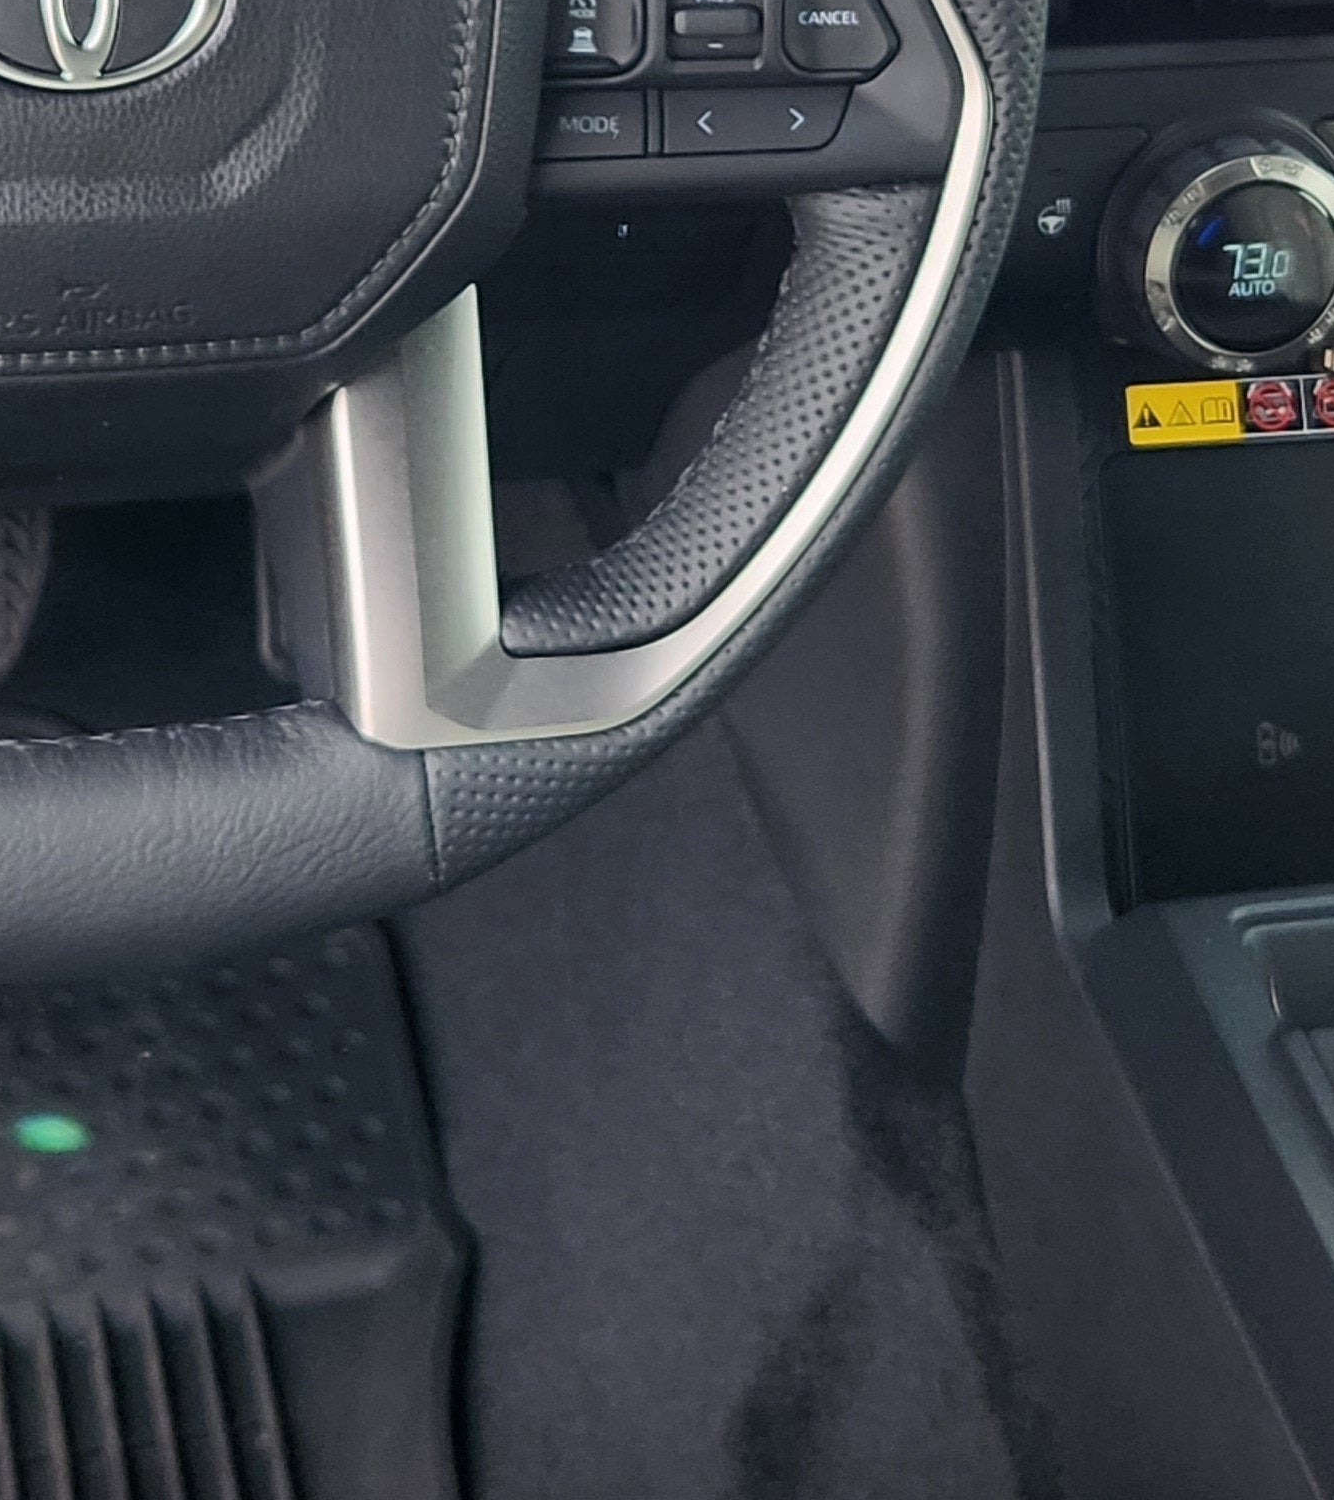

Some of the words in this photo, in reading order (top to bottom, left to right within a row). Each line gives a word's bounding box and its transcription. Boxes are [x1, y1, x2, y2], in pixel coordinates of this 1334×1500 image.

[798, 11, 859, 27] CANCEL
[559, 115, 620, 135] MODE
[1222, 243, 1290, 280] 73.0
[1228, 280, 1276, 297] AUTO
